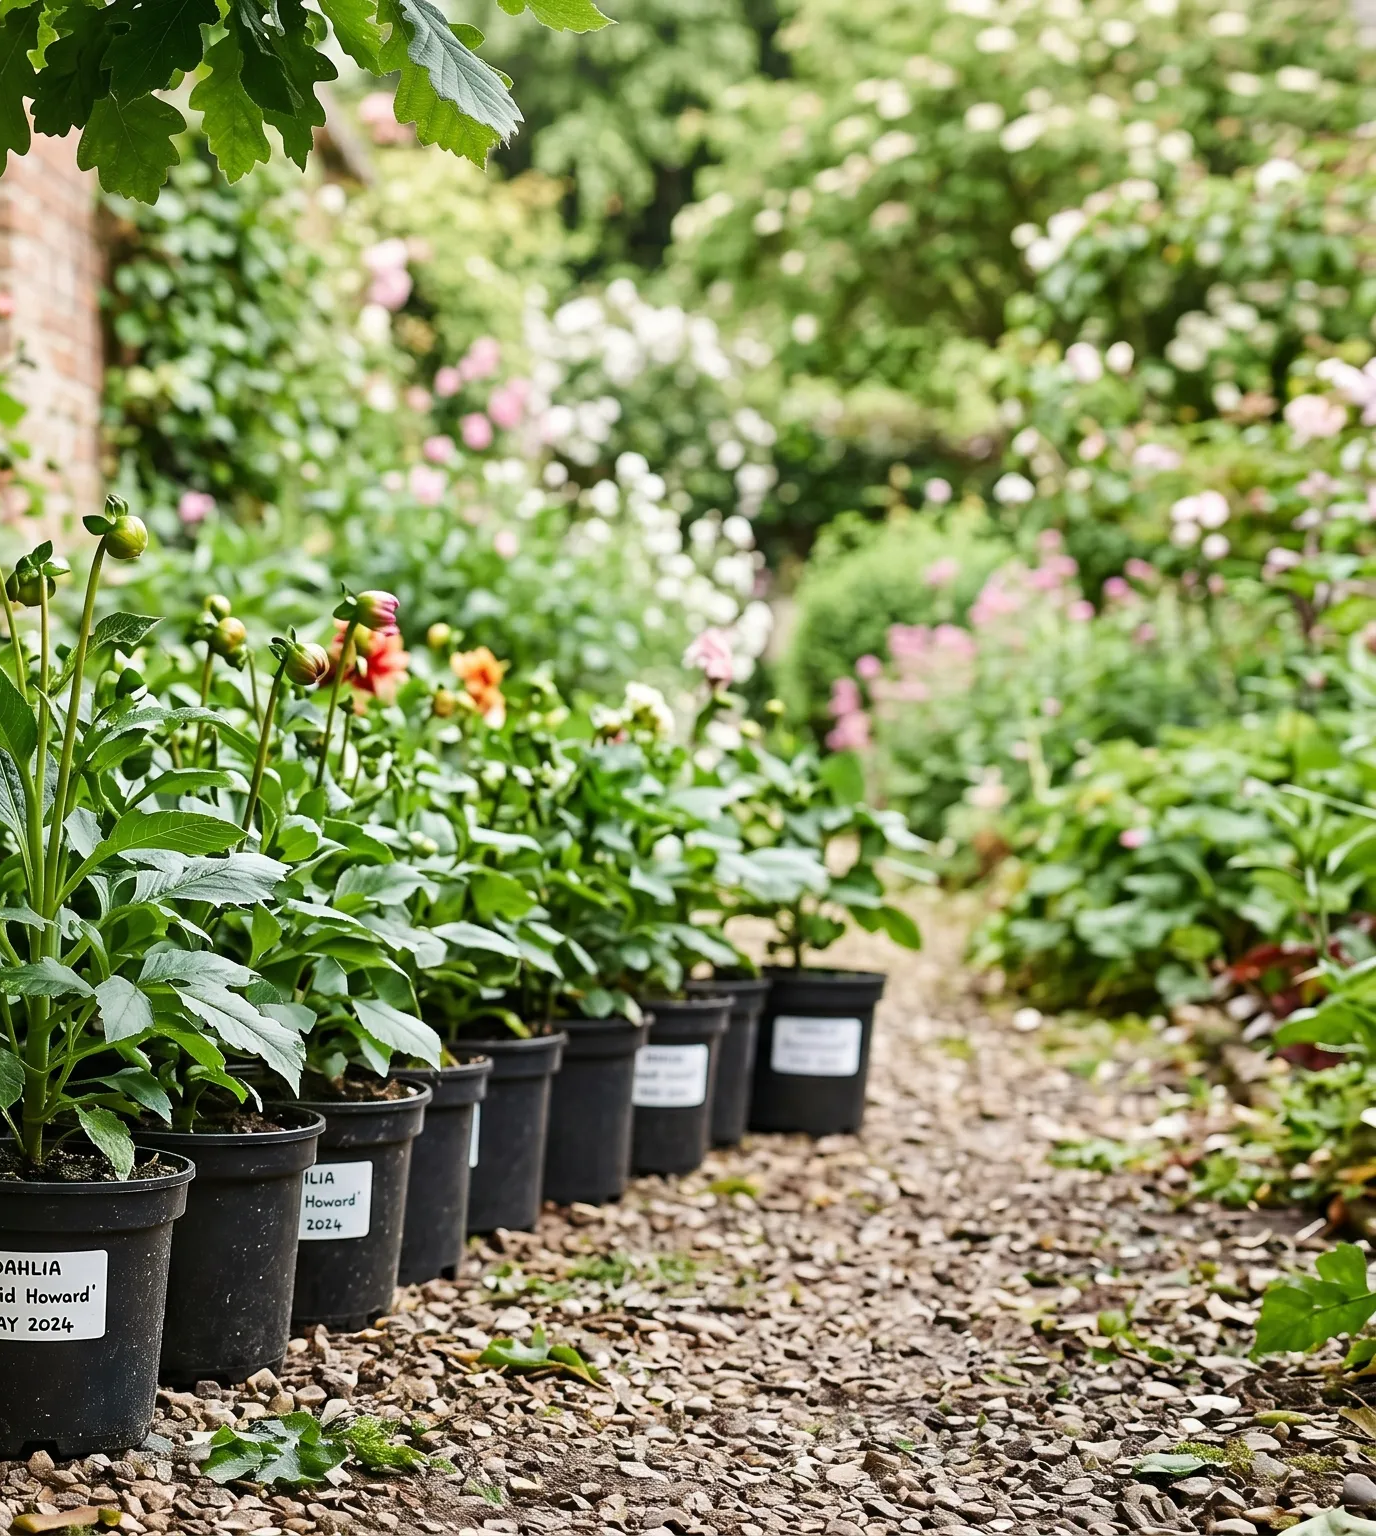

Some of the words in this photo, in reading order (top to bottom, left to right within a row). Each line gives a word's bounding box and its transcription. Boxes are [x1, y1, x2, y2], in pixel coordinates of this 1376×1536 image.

[305, 1190, 361, 1208] Howard'
[306, 1218, 343, 1232] 2024
[26, 1283, 96, 1304] Howard'
[27, 1316, 74, 1333] 2024
